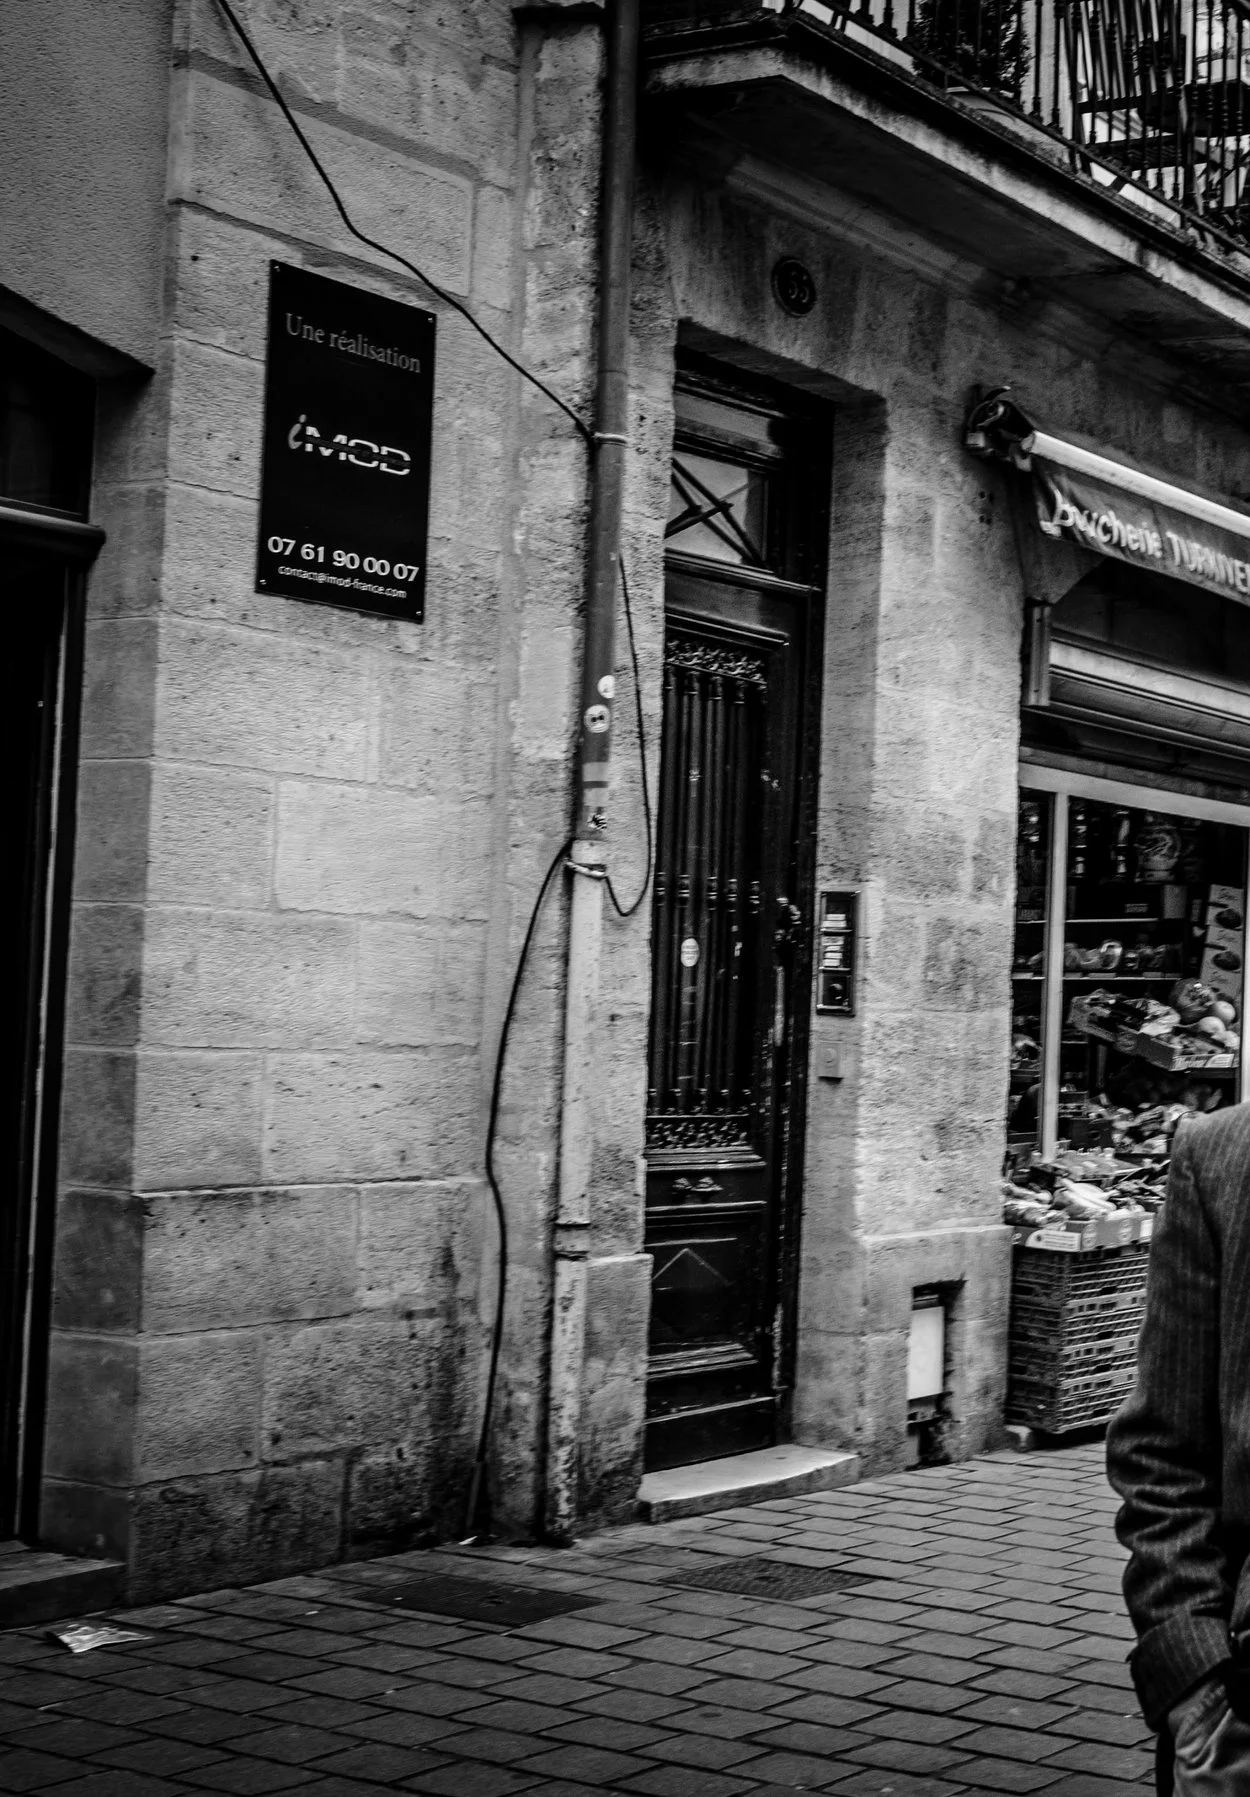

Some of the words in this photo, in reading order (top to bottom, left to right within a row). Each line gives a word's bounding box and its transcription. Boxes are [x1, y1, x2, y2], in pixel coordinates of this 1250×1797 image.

[286, 312, 325, 343] Une
[329, 330, 421, 373] réalisation
[267, 536, 296, 556] 07
[300, 543, 325, 563] 61
[332, 550, 360, 569] 90
[363, 557, 391, 576] 00
[393, 563, 420, 582] 07
[277, 565, 408, 599] contact@imod-france.com
